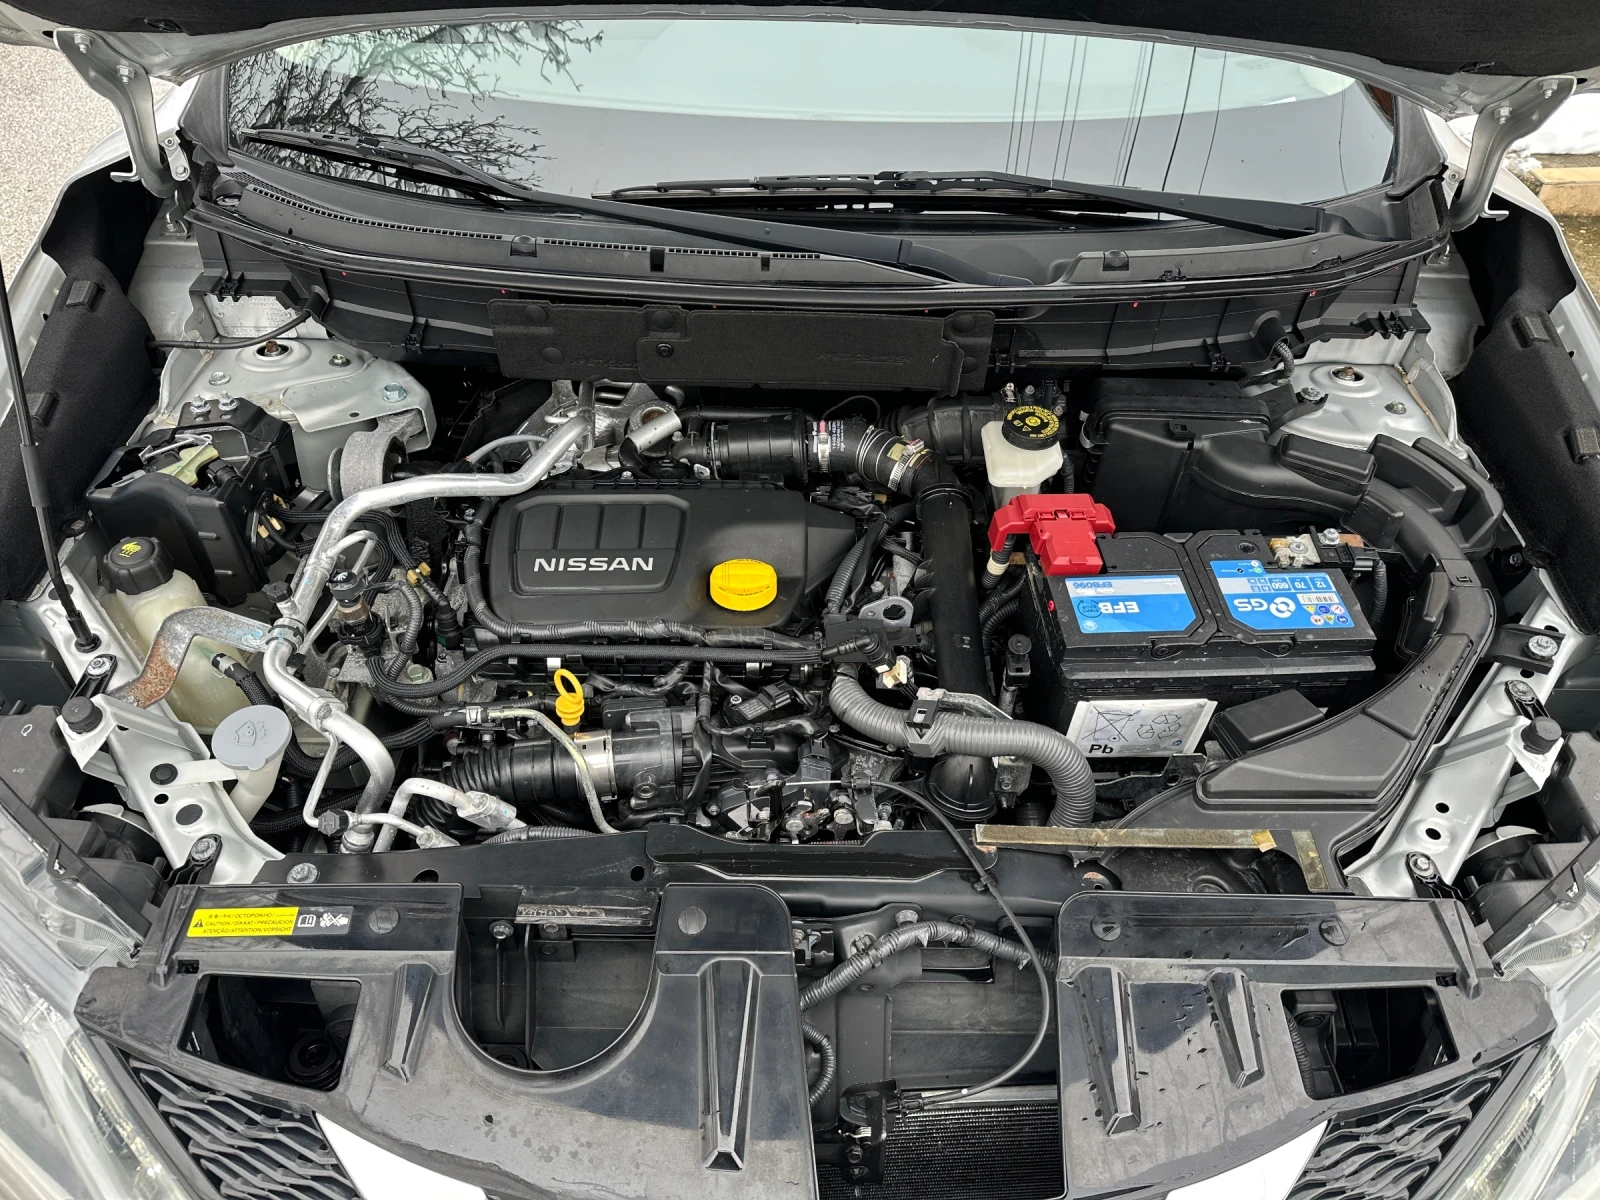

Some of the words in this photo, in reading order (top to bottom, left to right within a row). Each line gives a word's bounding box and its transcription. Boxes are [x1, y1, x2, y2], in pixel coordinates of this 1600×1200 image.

[533, 557, 654, 572] NISSAN
[1271, 581, 1289, 589] 650
[1294, 581, 1307, 589] 70
[1098, 602, 1140, 613] EFB
[1233, 598, 1268, 612] GS
[1088, 744, 1114, 754] Pb
